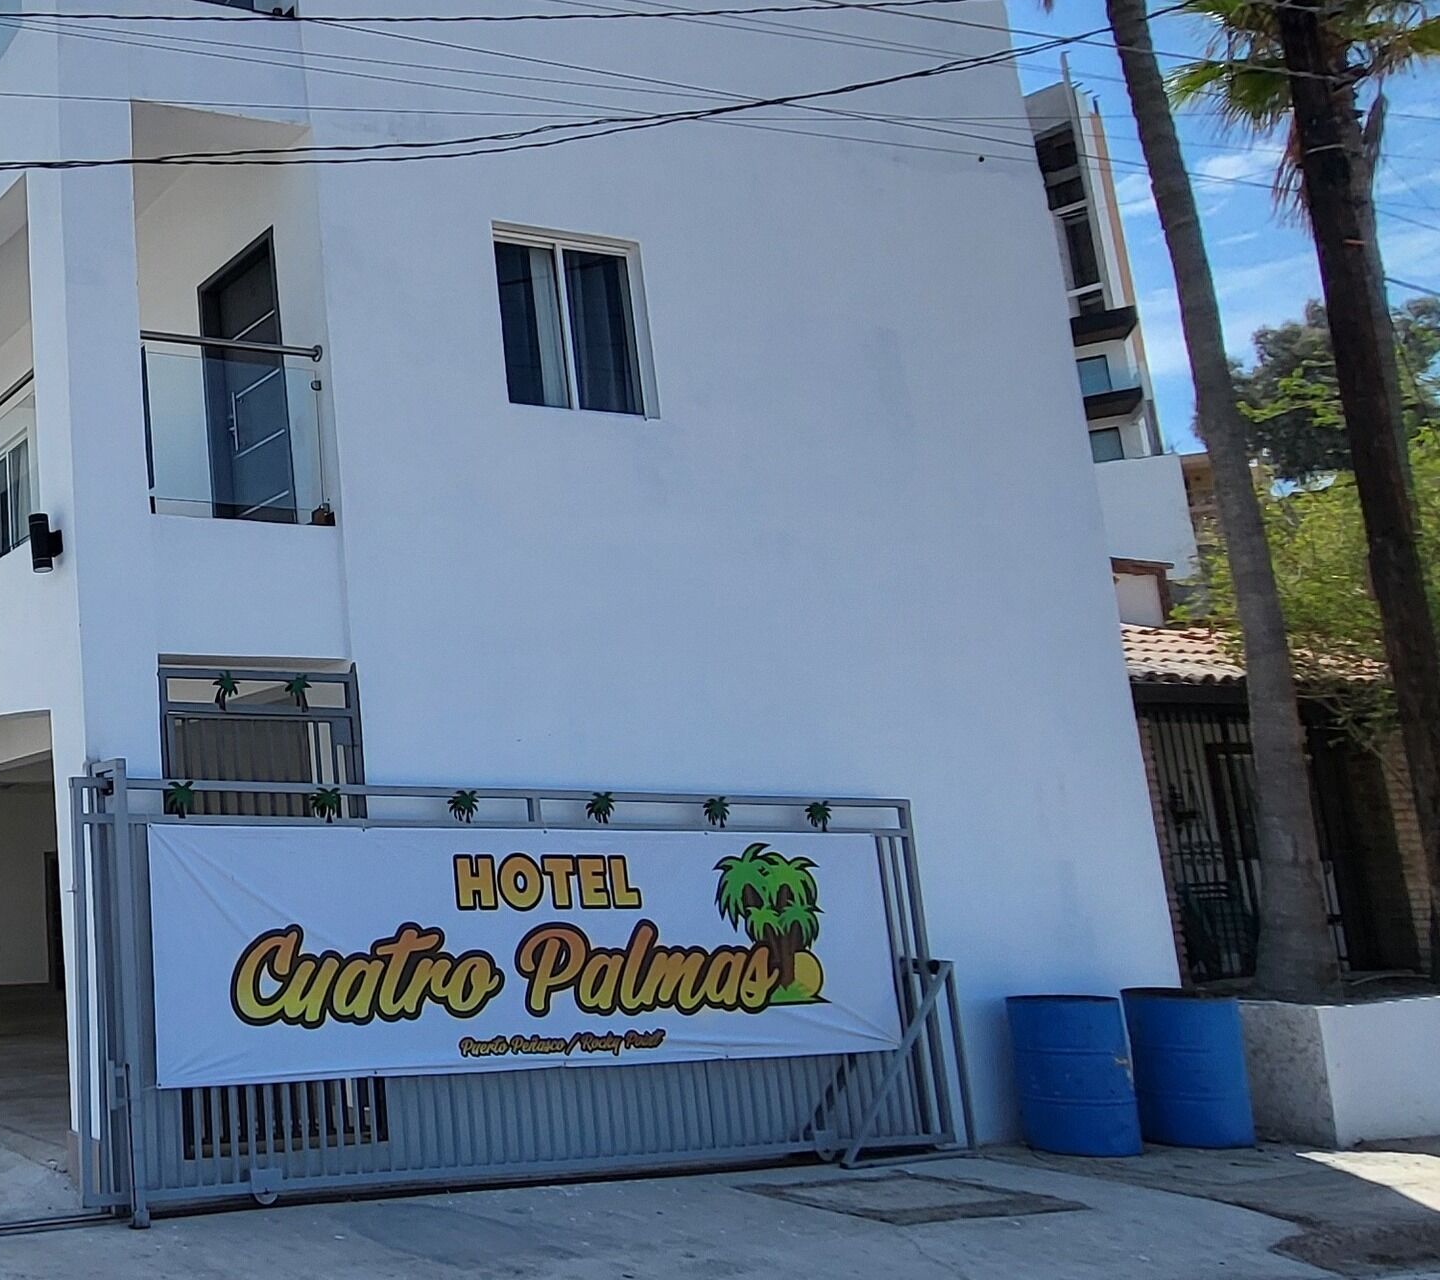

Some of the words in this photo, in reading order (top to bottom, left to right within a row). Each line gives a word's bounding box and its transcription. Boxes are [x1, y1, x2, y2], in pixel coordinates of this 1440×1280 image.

[454, 853, 642, 910] HOTEL
[231, 923, 504, 1029] Cuatro
[514, 919, 779, 1017] Palmas
[460, 1035, 509, 1057] Puerto
[510, 1034, 567, 1055] Peñasco
[579, 1031, 623, 1056] Rocky
[624, 1028, 666, 1049] Point
